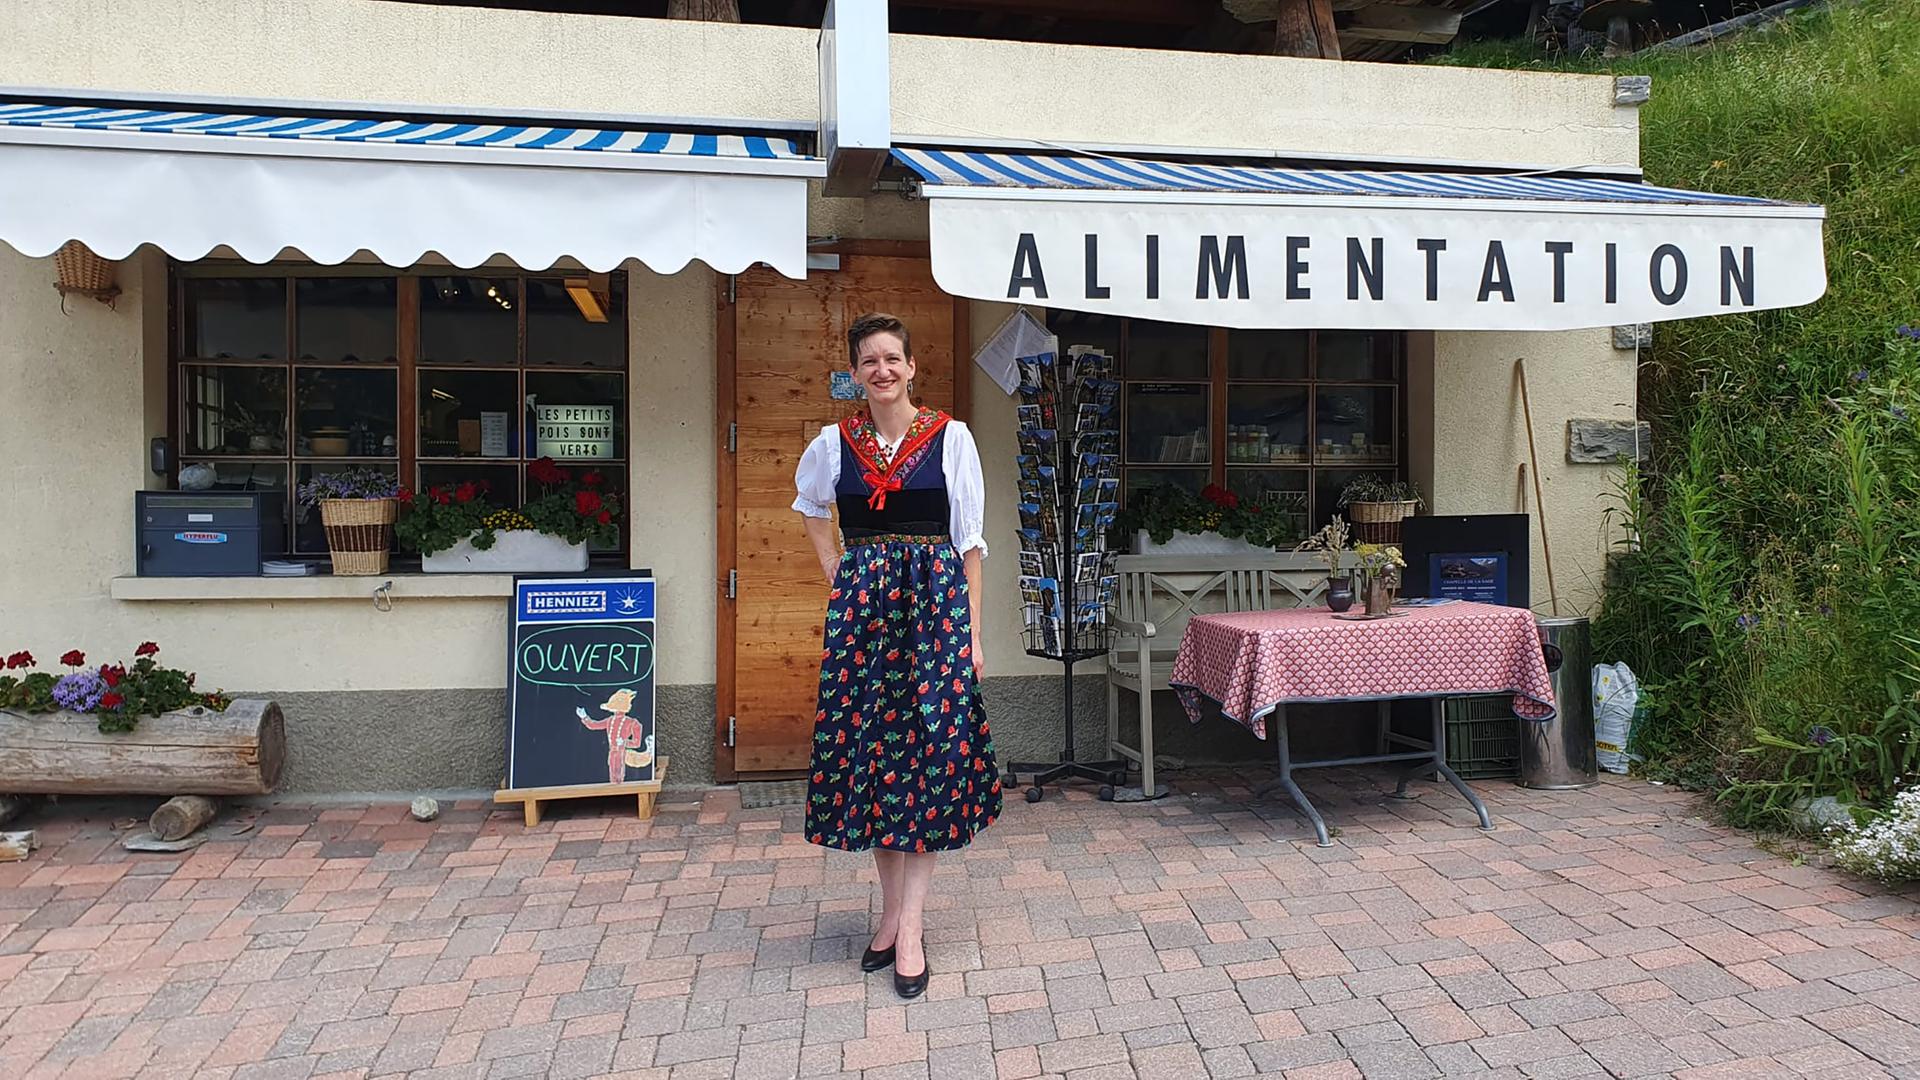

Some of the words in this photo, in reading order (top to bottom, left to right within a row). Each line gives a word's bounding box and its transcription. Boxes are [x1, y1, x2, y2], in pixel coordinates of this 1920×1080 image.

[1006, 232, 1755, 308] ALIMENTATION
[537, 408, 560, 421] LES
[565, 408, 612, 421] PETITS
[538, 426, 570, 439] POIS
[534, 596, 599, 609] HENNIEZ
[523, 643, 648, 676] OUVERT
